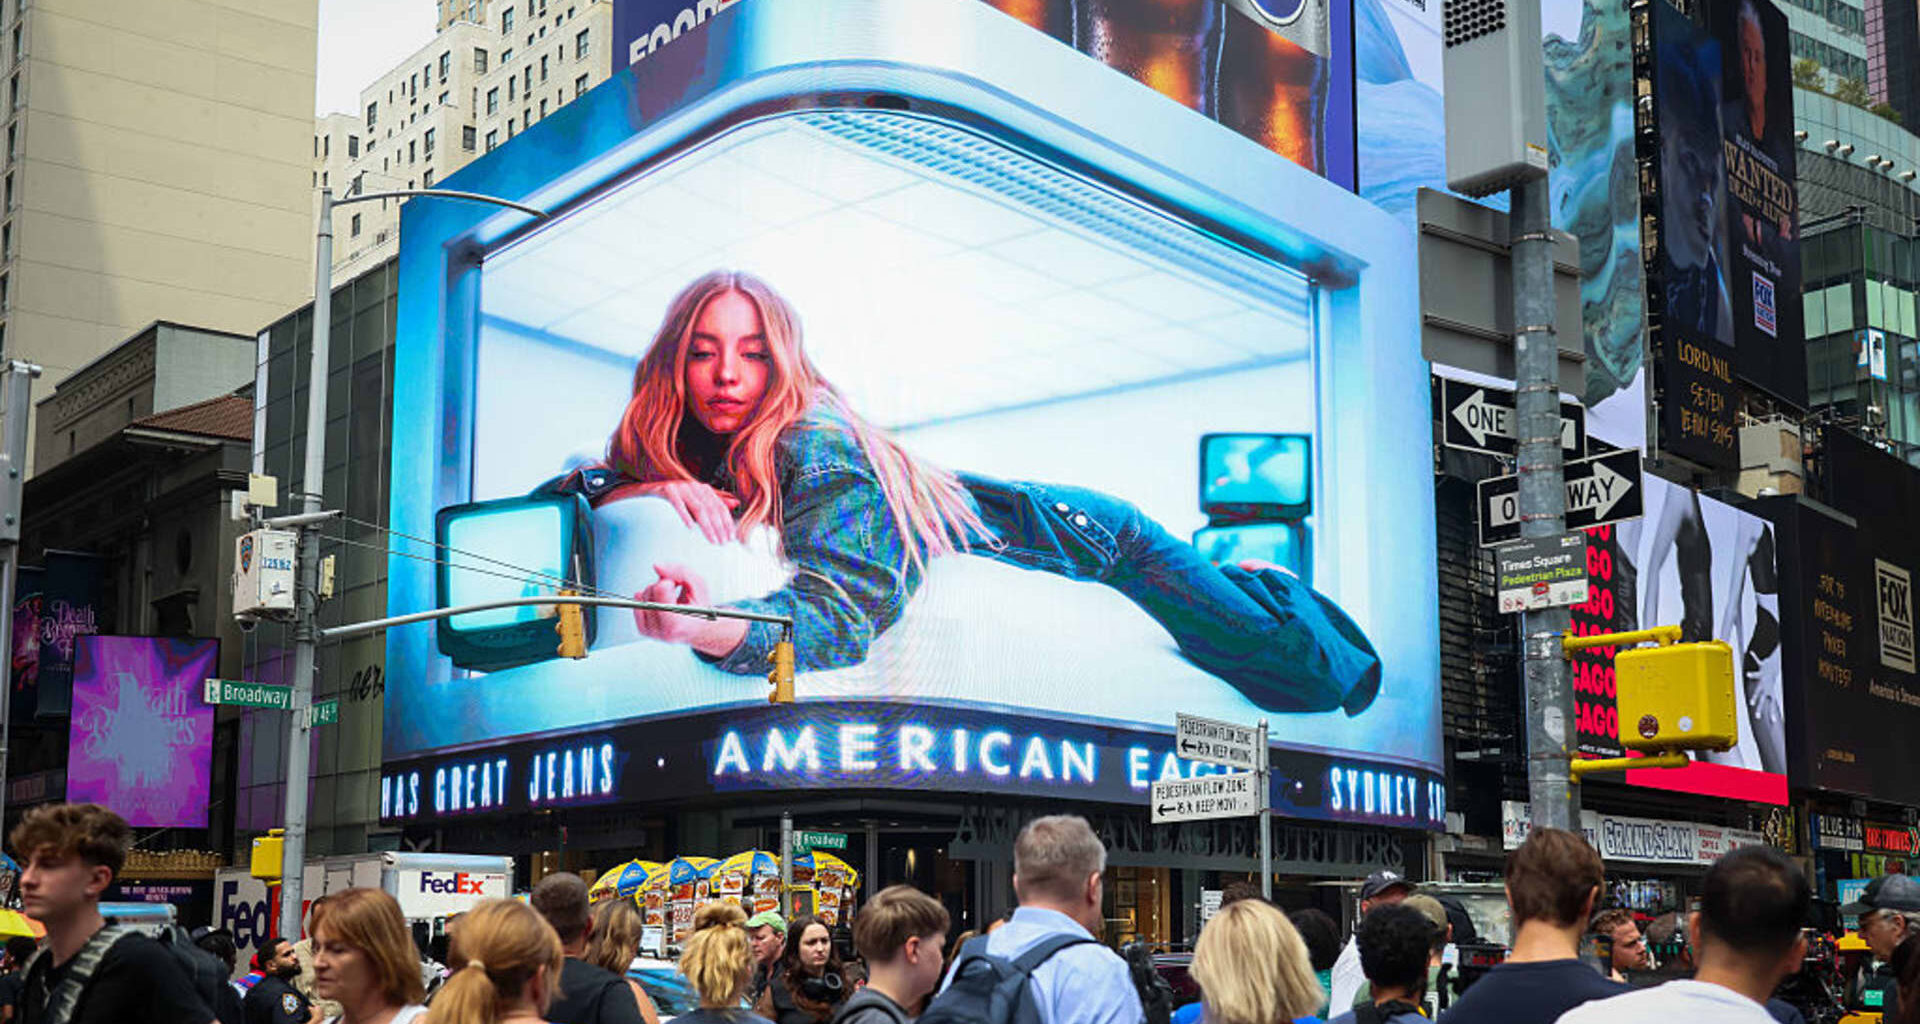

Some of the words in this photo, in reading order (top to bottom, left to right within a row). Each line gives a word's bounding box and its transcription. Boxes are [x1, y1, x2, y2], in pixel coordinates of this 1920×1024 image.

[1724, 139, 1793, 213] WANTED
[1678, 338, 1711, 373] LORD
[1711, 355, 1733, 384] NIL
[1466, 403, 1507, 434] ONE
[1568, 476, 1615, 509] WAY
[1502, 560, 1533, 572] Times
[1533, 554, 1573, 568] Square
[1878, 575, 1910, 623] FOX
[224, 684, 288, 709] Broadway
[714, 723, 1096, 784] AMERICAN
[381, 772, 419, 818] HAS
[435, 760, 507, 812] GREAT
[529, 744, 613, 802] JEANS
[1331, 767, 1417, 818] SYDNEY
[1818, 815, 1844, 836] BLUE
[420, 872, 483, 894] FedEx
